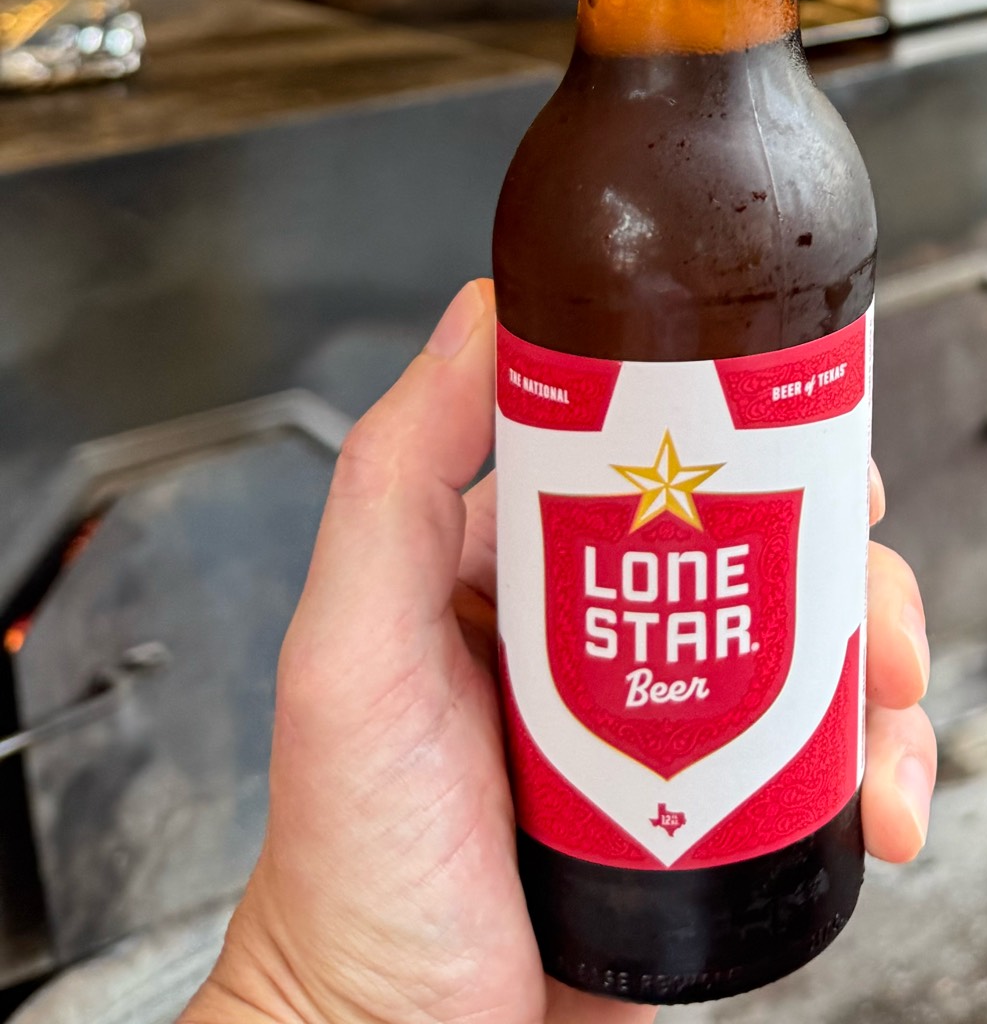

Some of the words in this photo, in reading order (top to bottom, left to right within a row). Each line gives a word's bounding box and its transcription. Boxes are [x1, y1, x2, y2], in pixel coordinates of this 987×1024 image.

[509, 367, 522, 388] THE
[522, 376, 570, 405] NATIONAL
[772, 381, 802, 402] BEER
[804, 374, 816, 397] of
[584, 543, 749, 603] LONE
[625, 667, 710, 708] Beer
